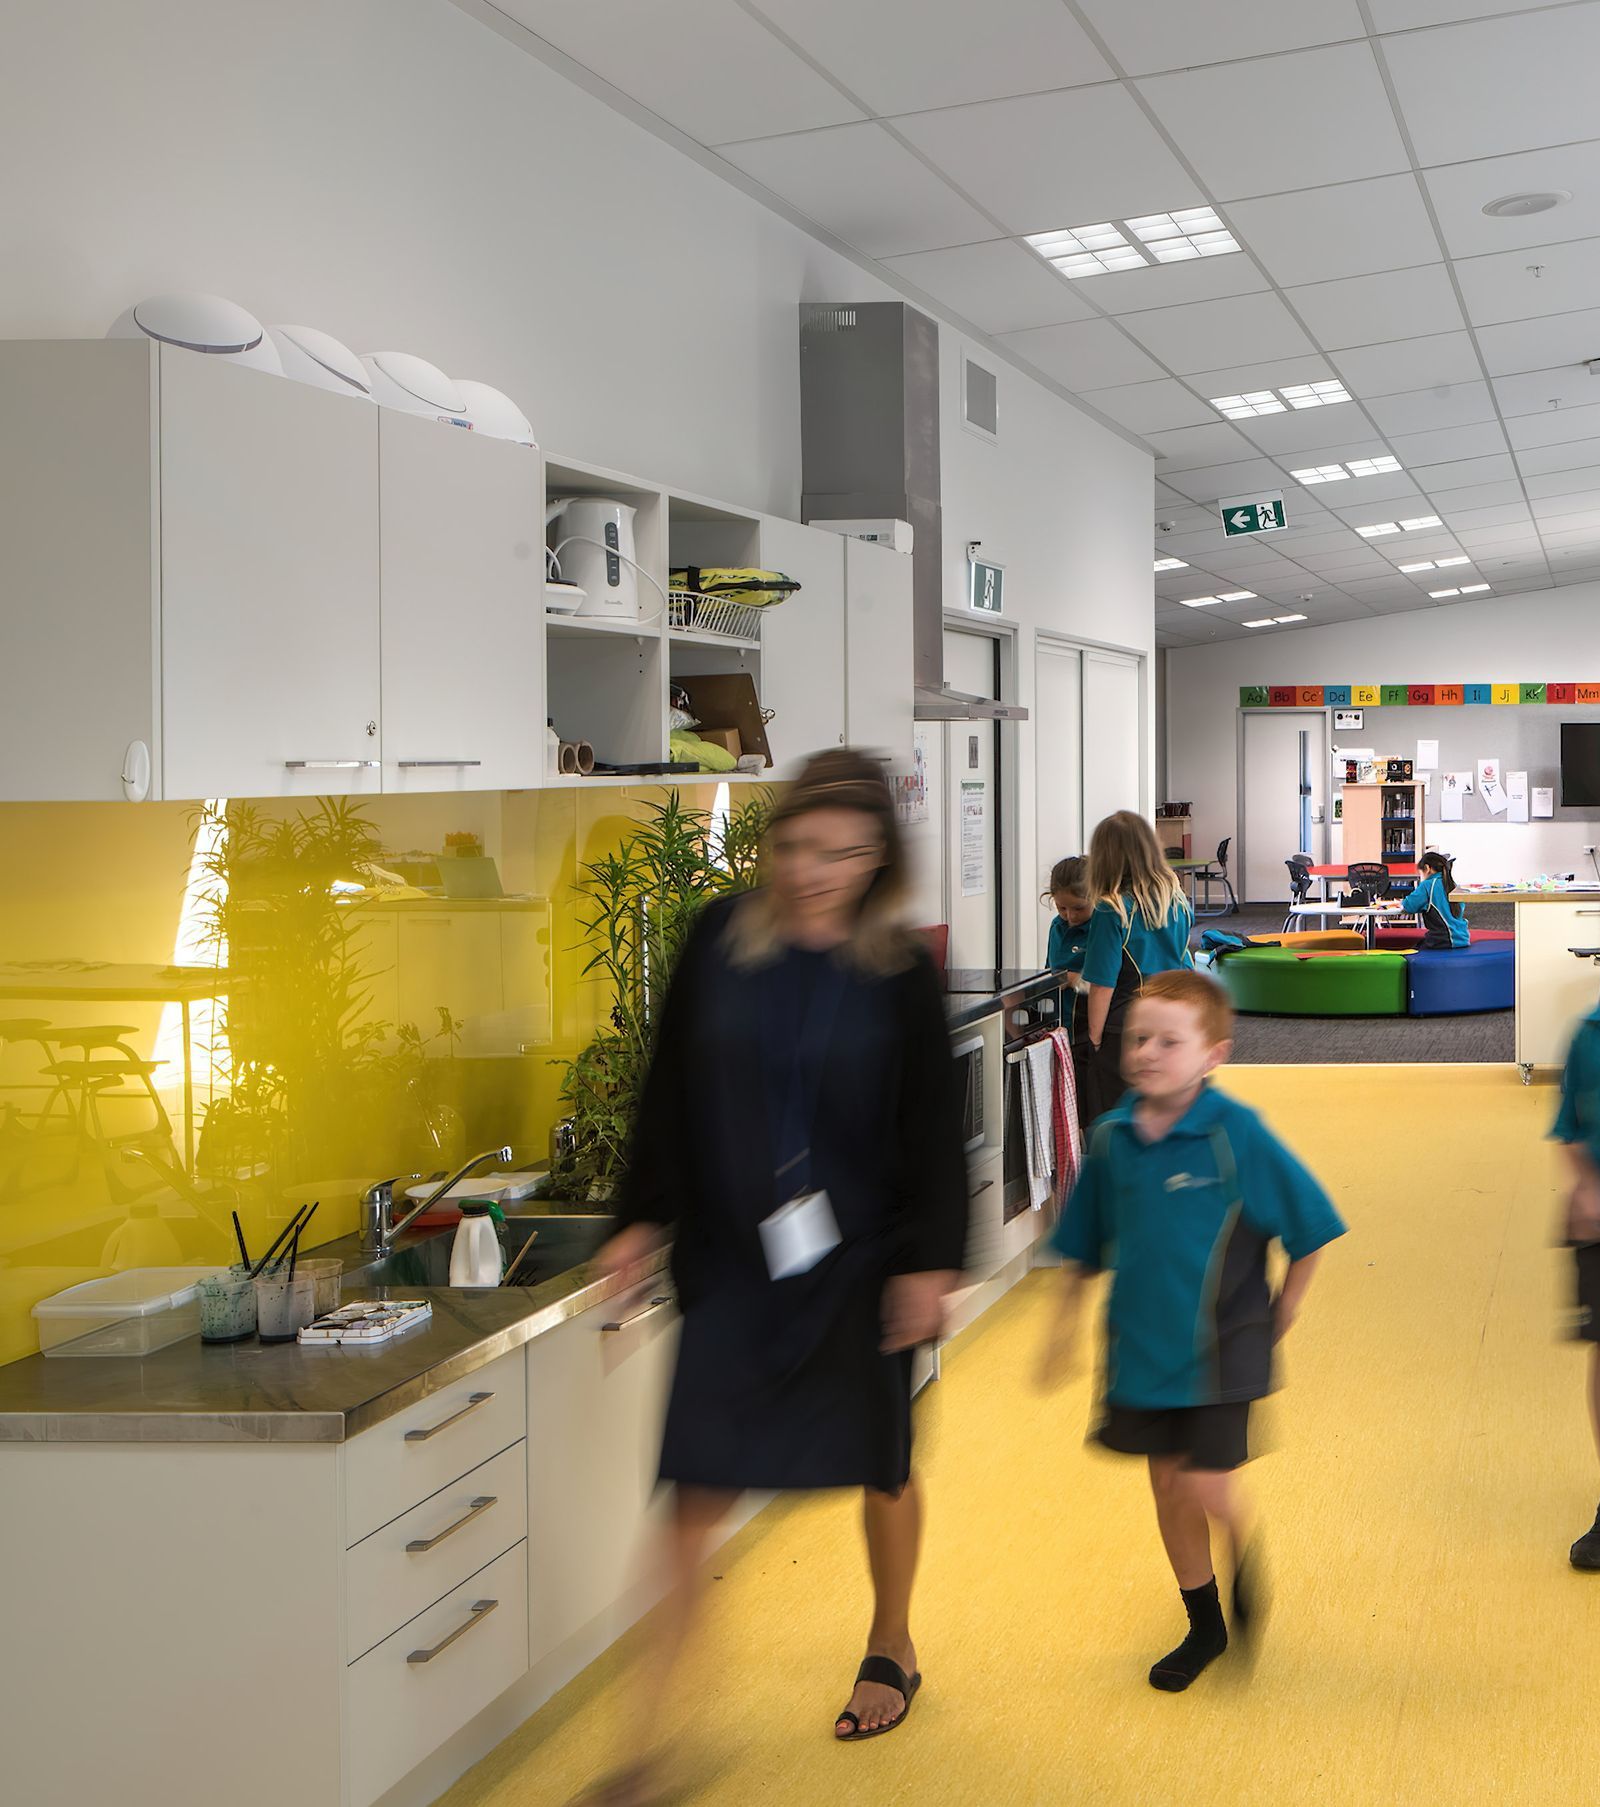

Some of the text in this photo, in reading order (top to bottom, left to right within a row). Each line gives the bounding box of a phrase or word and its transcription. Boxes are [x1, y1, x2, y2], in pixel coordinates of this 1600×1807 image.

[1274, 691, 1290, 703] Bb
[1302, 690, 1317, 703] Cc
[1329, 691, 1345, 702] Dd
[1359, 690, 1373, 702] Ee
[1388, 690, 1398, 701] Ff
[1412, 690, 1429, 703] Gg
[1441, 689, 1458, 700] Hh
[1473, 690, 1481, 701] Ii
[1500, 689, 1510, 703] Jj
[1525, 689, 1540, 700] Kk
[1556, 688, 1566, 699] Ll
[1577, 688, 1599, 699] Mm
